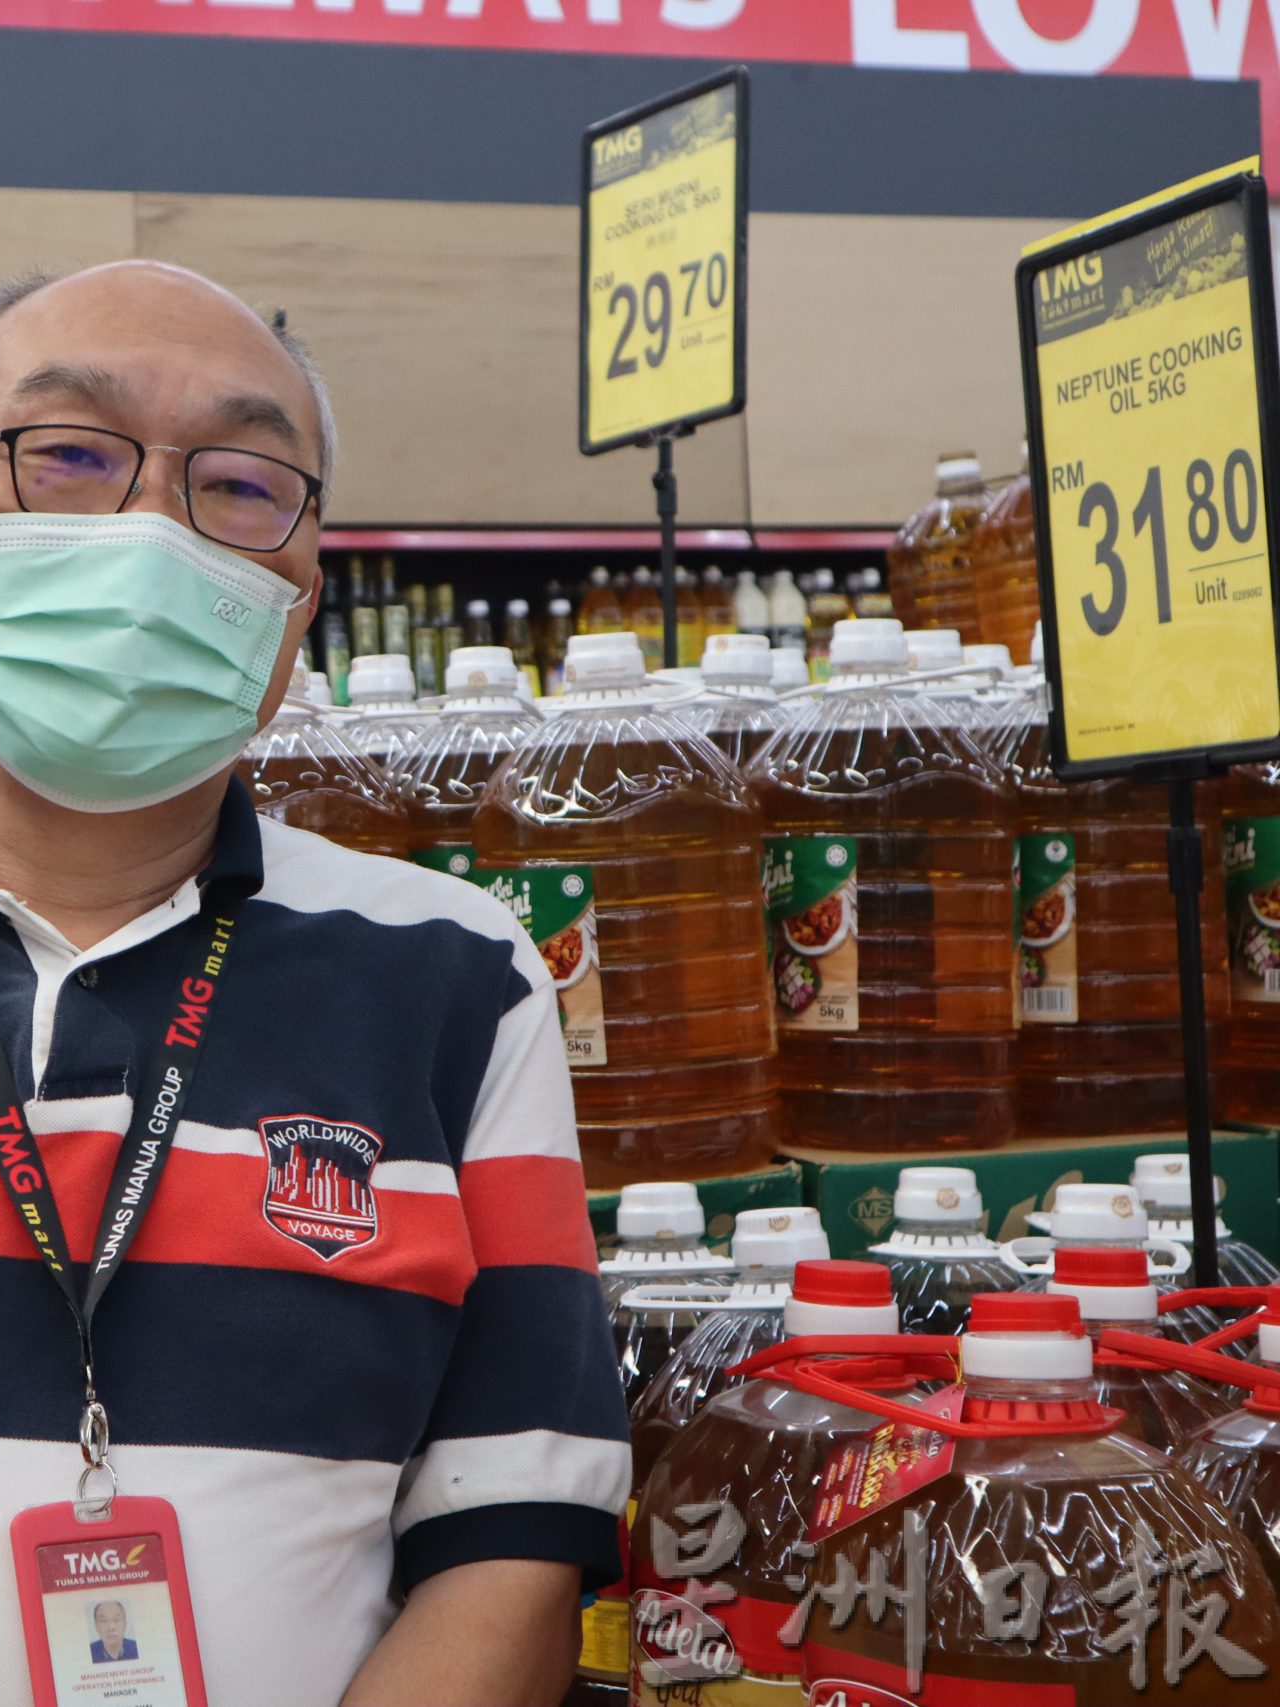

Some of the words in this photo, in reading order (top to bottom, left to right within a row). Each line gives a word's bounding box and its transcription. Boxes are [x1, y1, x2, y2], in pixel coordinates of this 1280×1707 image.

[593, 125, 642, 165] TMG
[605, 212, 665, 241] COOKING
[667, 201, 688, 218] OIL
[593, 271, 616, 294] RM
[679, 251, 728, 317] 70
[606, 270, 672, 380] 29
[680, 328, 704, 350] Unit
[1057, 356, 1144, 404] NEPTUNE
[1149, 326, 1243, 376] COOKING
[1110, 387, 1141, 415] OIL
[1148, 371, 1187, 404] 5KG
[1051, 460, 1084, 494] RM
[1186, 448, 1258, 552] 80
[1078, 465, 1172, 637] 31
[1195, 577, 1228, 605] Unit
[202, 916, 235, 976] mart
[165, 976, 214, 1049] TMG
[820, 1005, 844, 1019] 5kg
[567, 1039, 592, 1054] 5kg
[148, 1066, 184, 1135] GROUP
[268, 1123, 376, 1166] WORLDWIDE
[121, 1139, 161, 1206] MANJA
[858, 1199, 893, 1217] MS
[21, 1202, 65, 1273] mart
[95, 1208, 134, 1274] TUNAS
[287, 1219, 357, 1242] VOYAGE
[55, 1577, 85, 1587] TUNAS
[87, 1573, 118, 1585] MANJA
[119, 1570, 150, 1581] GROUP
[636, 1599, 728, 1674] Adela
[72, 1681, 112, 1692] OPERATION
[80, 1670, 128, 1681] MANAGEMENT
[130, 1666, 155, 1676] GROUP
[103, 1688, 138, 1698] MANAGER
